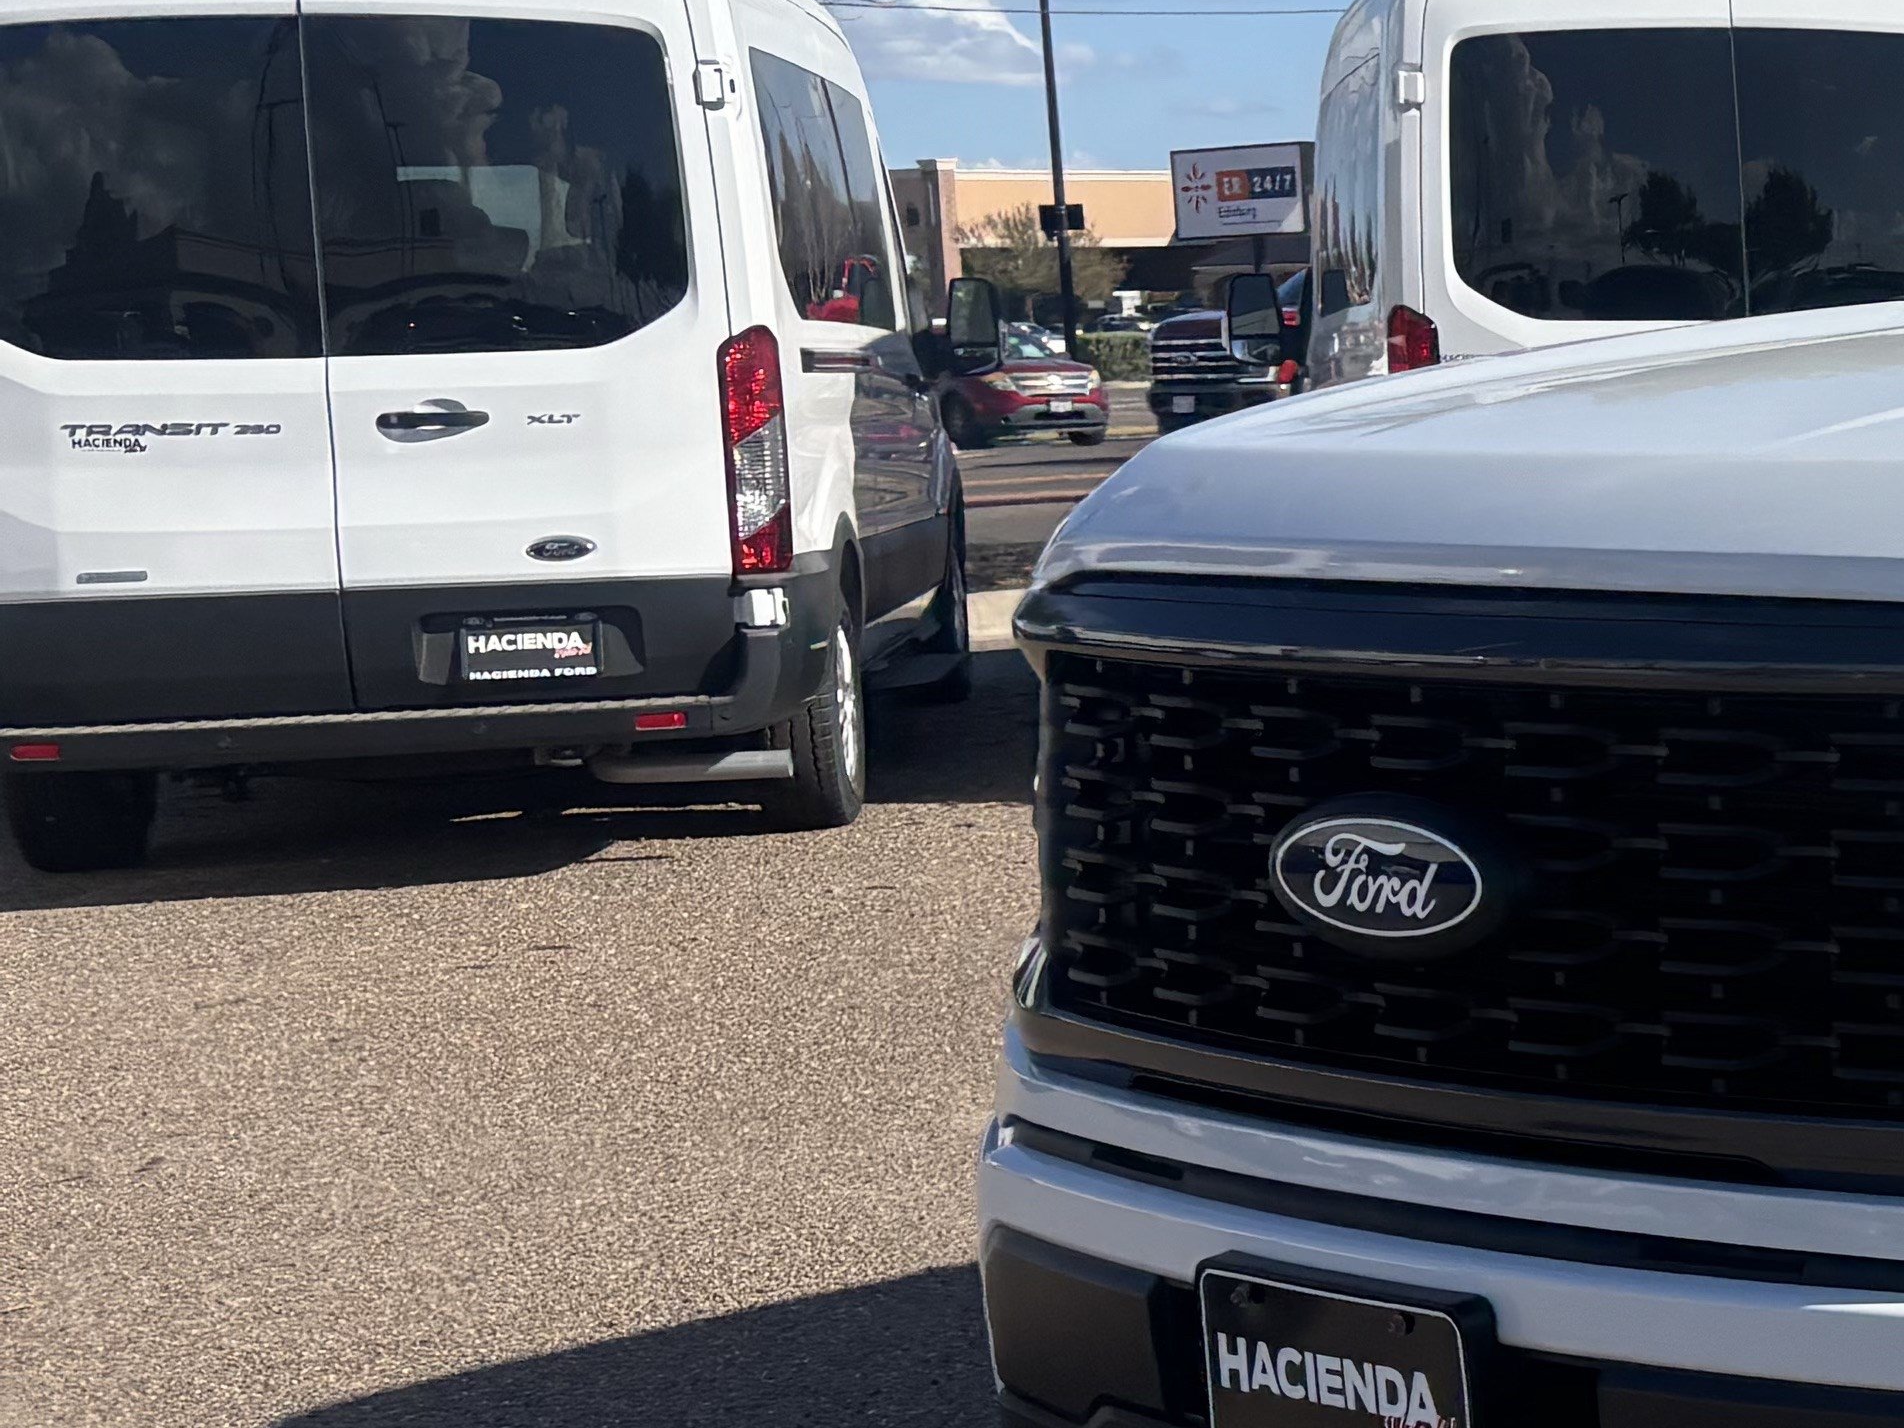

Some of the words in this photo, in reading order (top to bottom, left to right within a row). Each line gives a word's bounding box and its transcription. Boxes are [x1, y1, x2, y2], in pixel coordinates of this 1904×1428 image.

[1252, 174, 1293, 193] 24/7
[527, 414, 581, 425] XLT
[60, 422, 230, 438] TRANSIT
[71, 437, 141, 450] HACIENDA
[467, 632, 586, 654] HACIENDA
[469, 668, 551, 681] HACIENDA
[554, 666, 598, 678] FORD
[1313, 831, 1437, 920] Ford
[1216, 1332, 1438, 1428] HACIENDA
